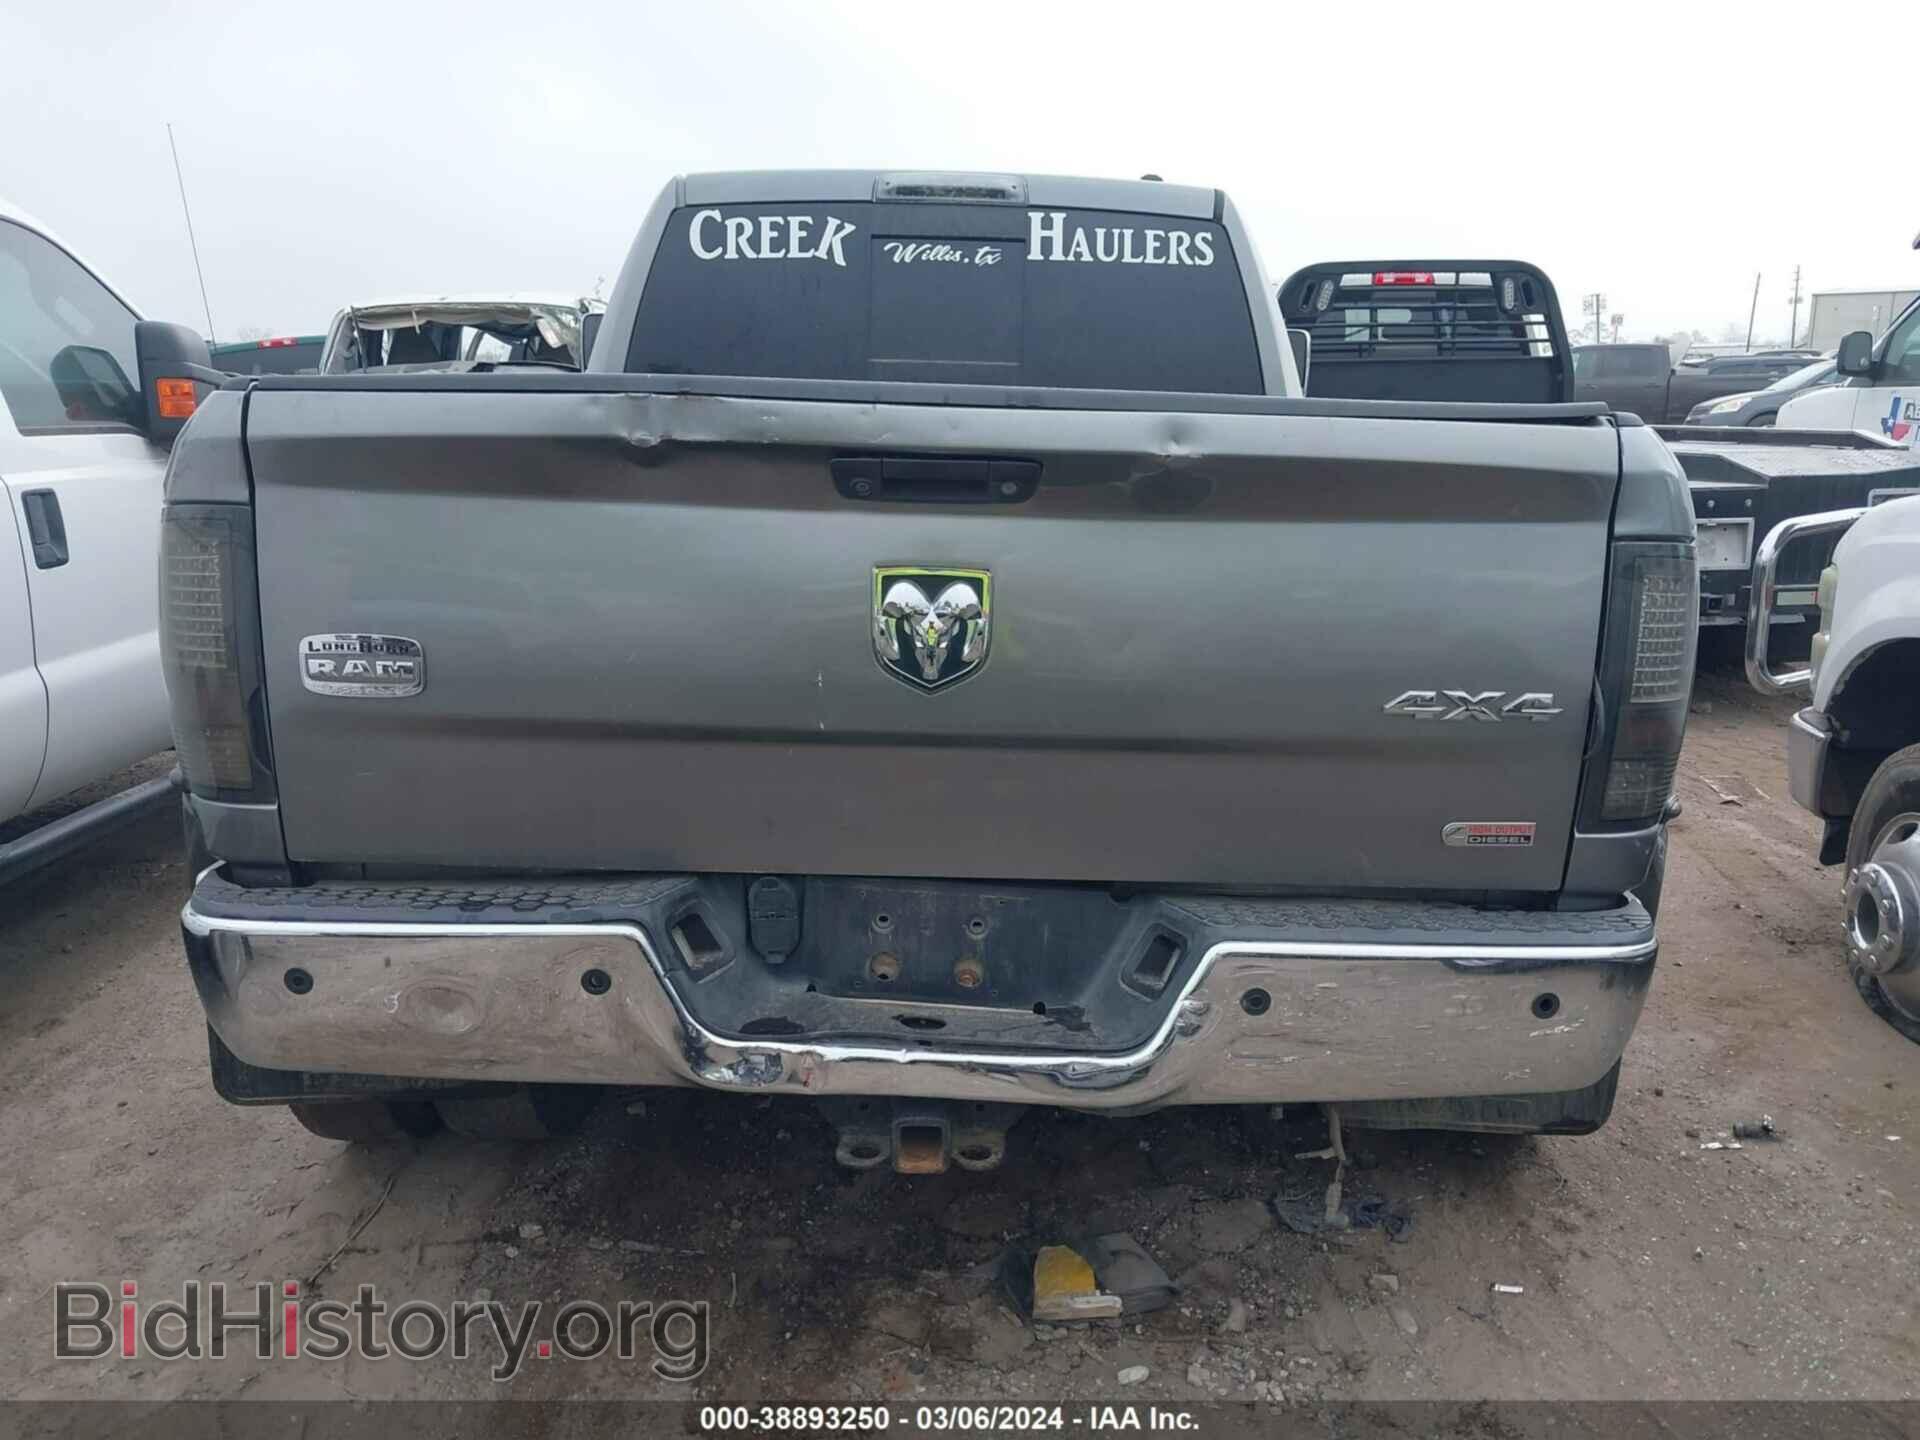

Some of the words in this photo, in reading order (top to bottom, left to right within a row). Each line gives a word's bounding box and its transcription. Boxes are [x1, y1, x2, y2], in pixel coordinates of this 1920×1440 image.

[689, 209, 857, 266] CREEK
[1026, 211, 1215, 266] HAULERS
[307, 659, 414, 678] RAM
